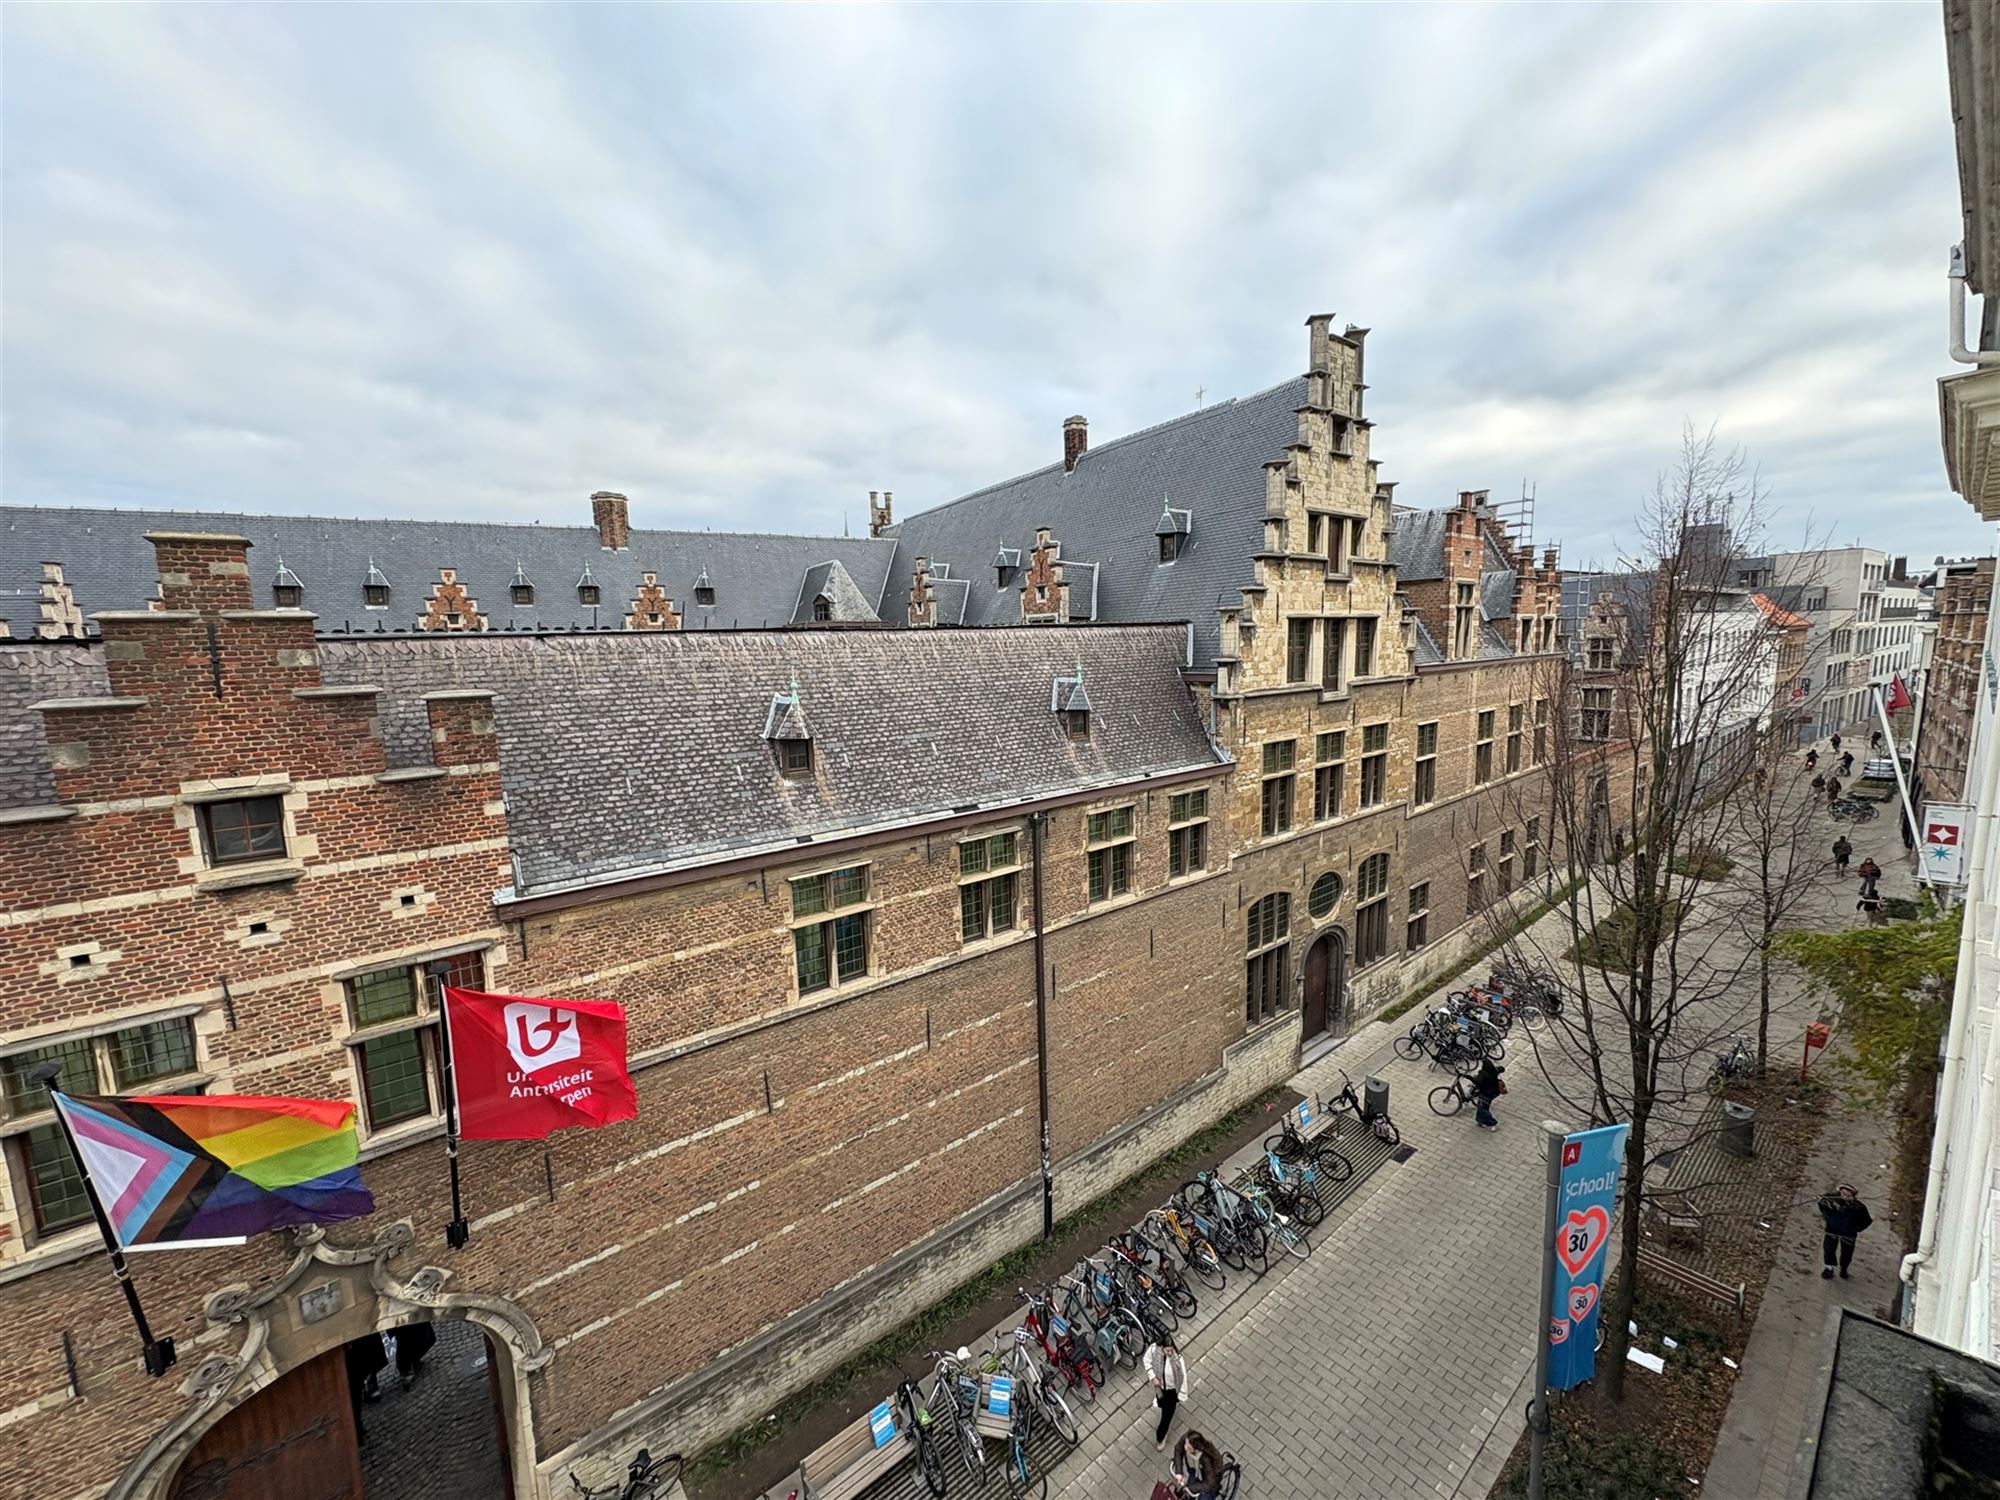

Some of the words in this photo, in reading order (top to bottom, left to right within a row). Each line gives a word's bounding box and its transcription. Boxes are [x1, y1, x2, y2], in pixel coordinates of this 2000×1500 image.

[1567, 1148, 1576, 1161] A
[1568, 1232, 1588, 1253] 30
[1574, 1298, 1588, 1310] 30
